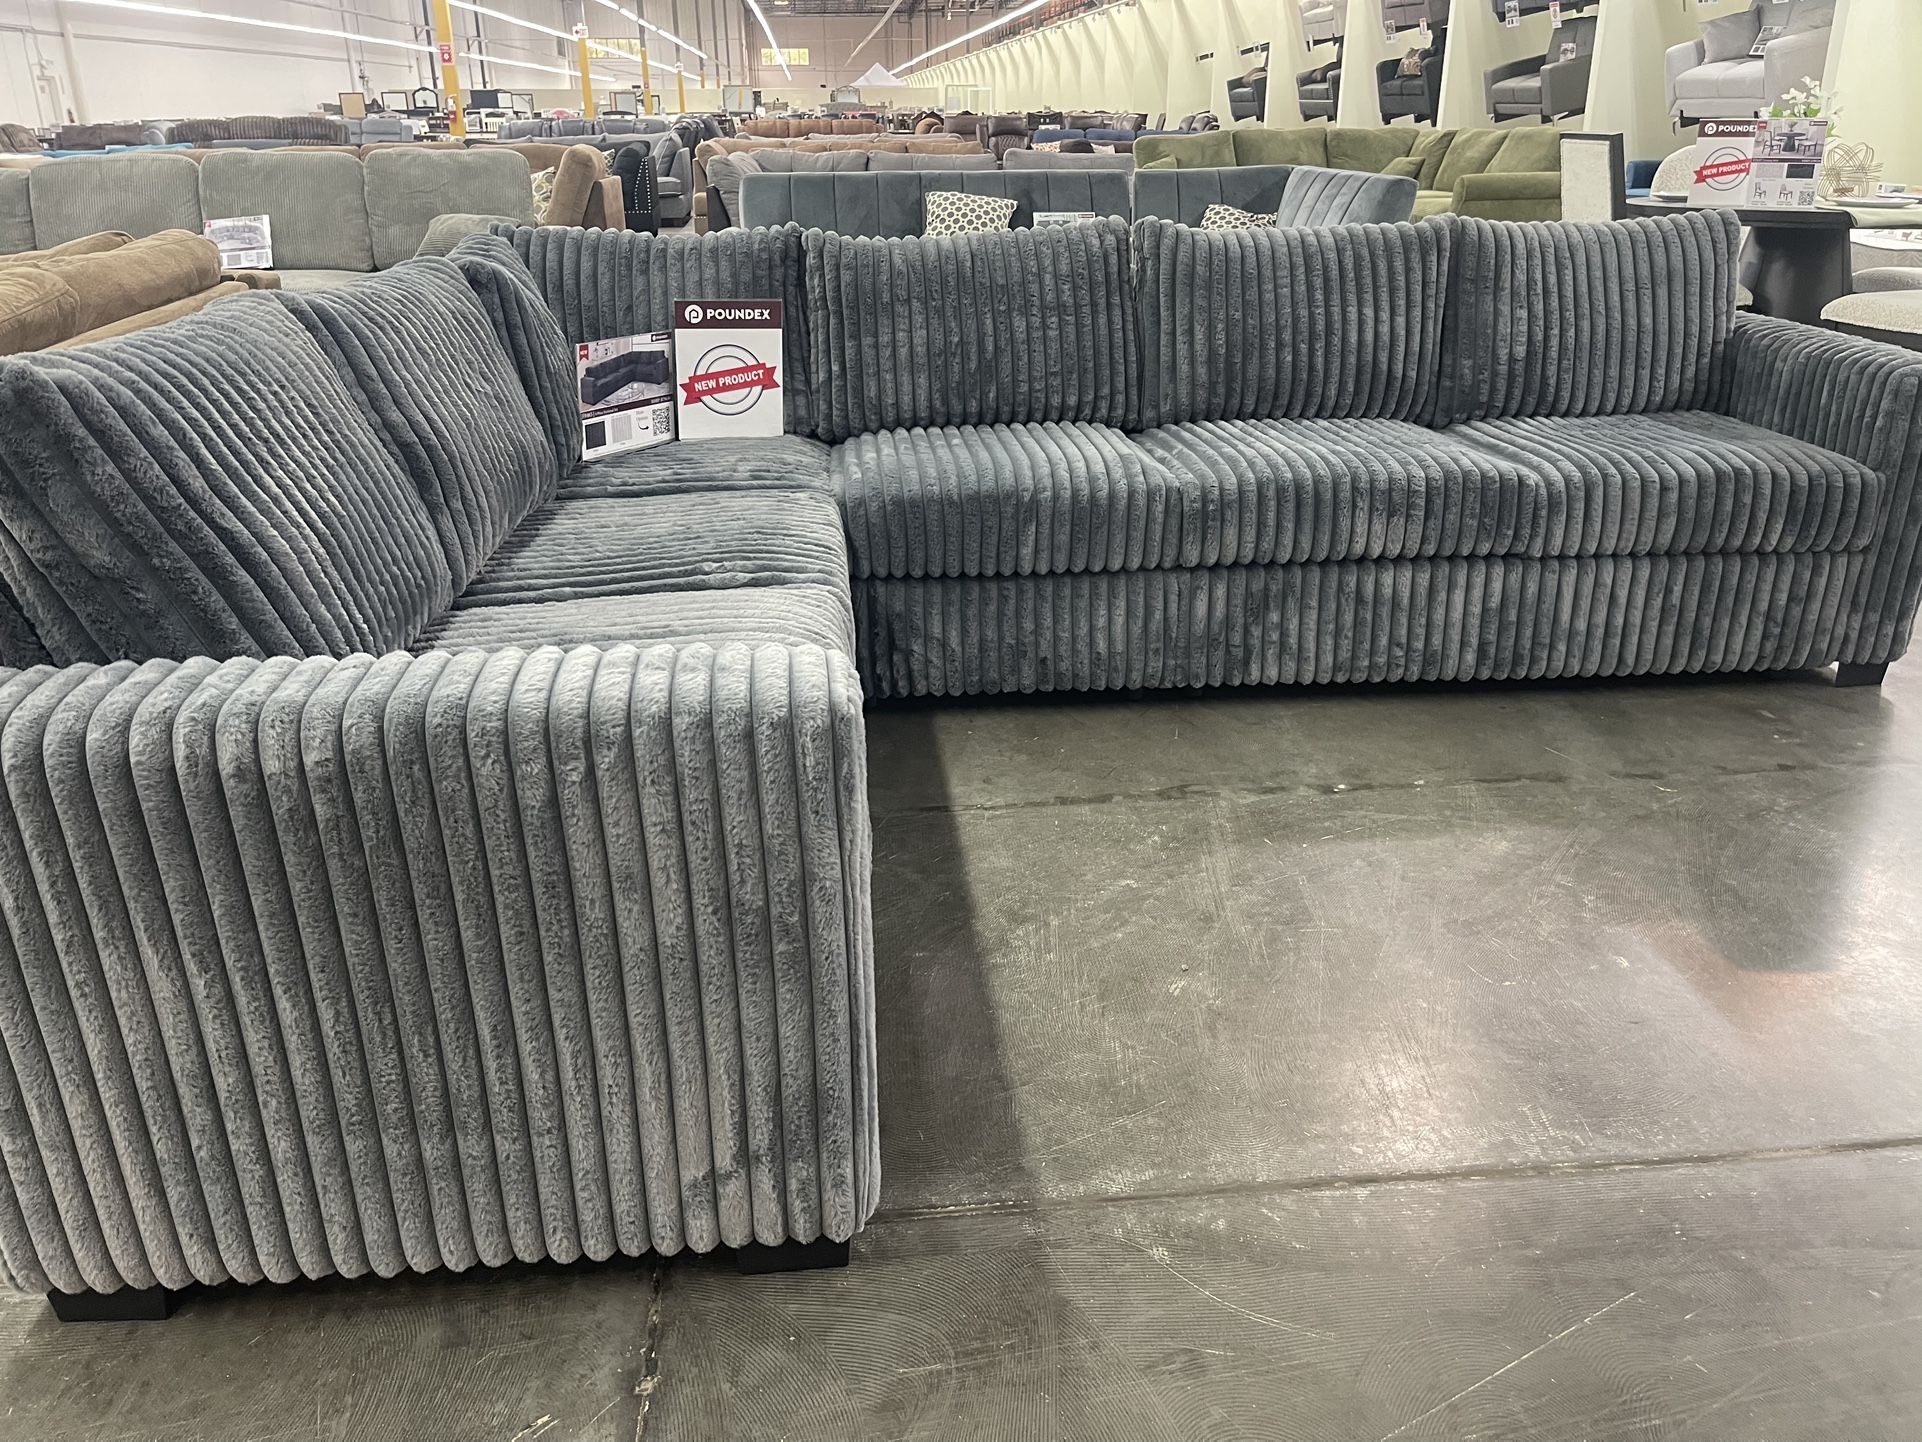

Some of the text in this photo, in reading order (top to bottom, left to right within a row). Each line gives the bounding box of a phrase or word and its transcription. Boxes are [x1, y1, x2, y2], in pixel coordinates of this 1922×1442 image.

[1718, 124, 1757, 133] POUNDE
[1702, 162, 1749, 176] NEW PRODUCT
[706, 308, 770, 320] POUNDEX
[694, 369, 764, 392] NEW PRODUCT
